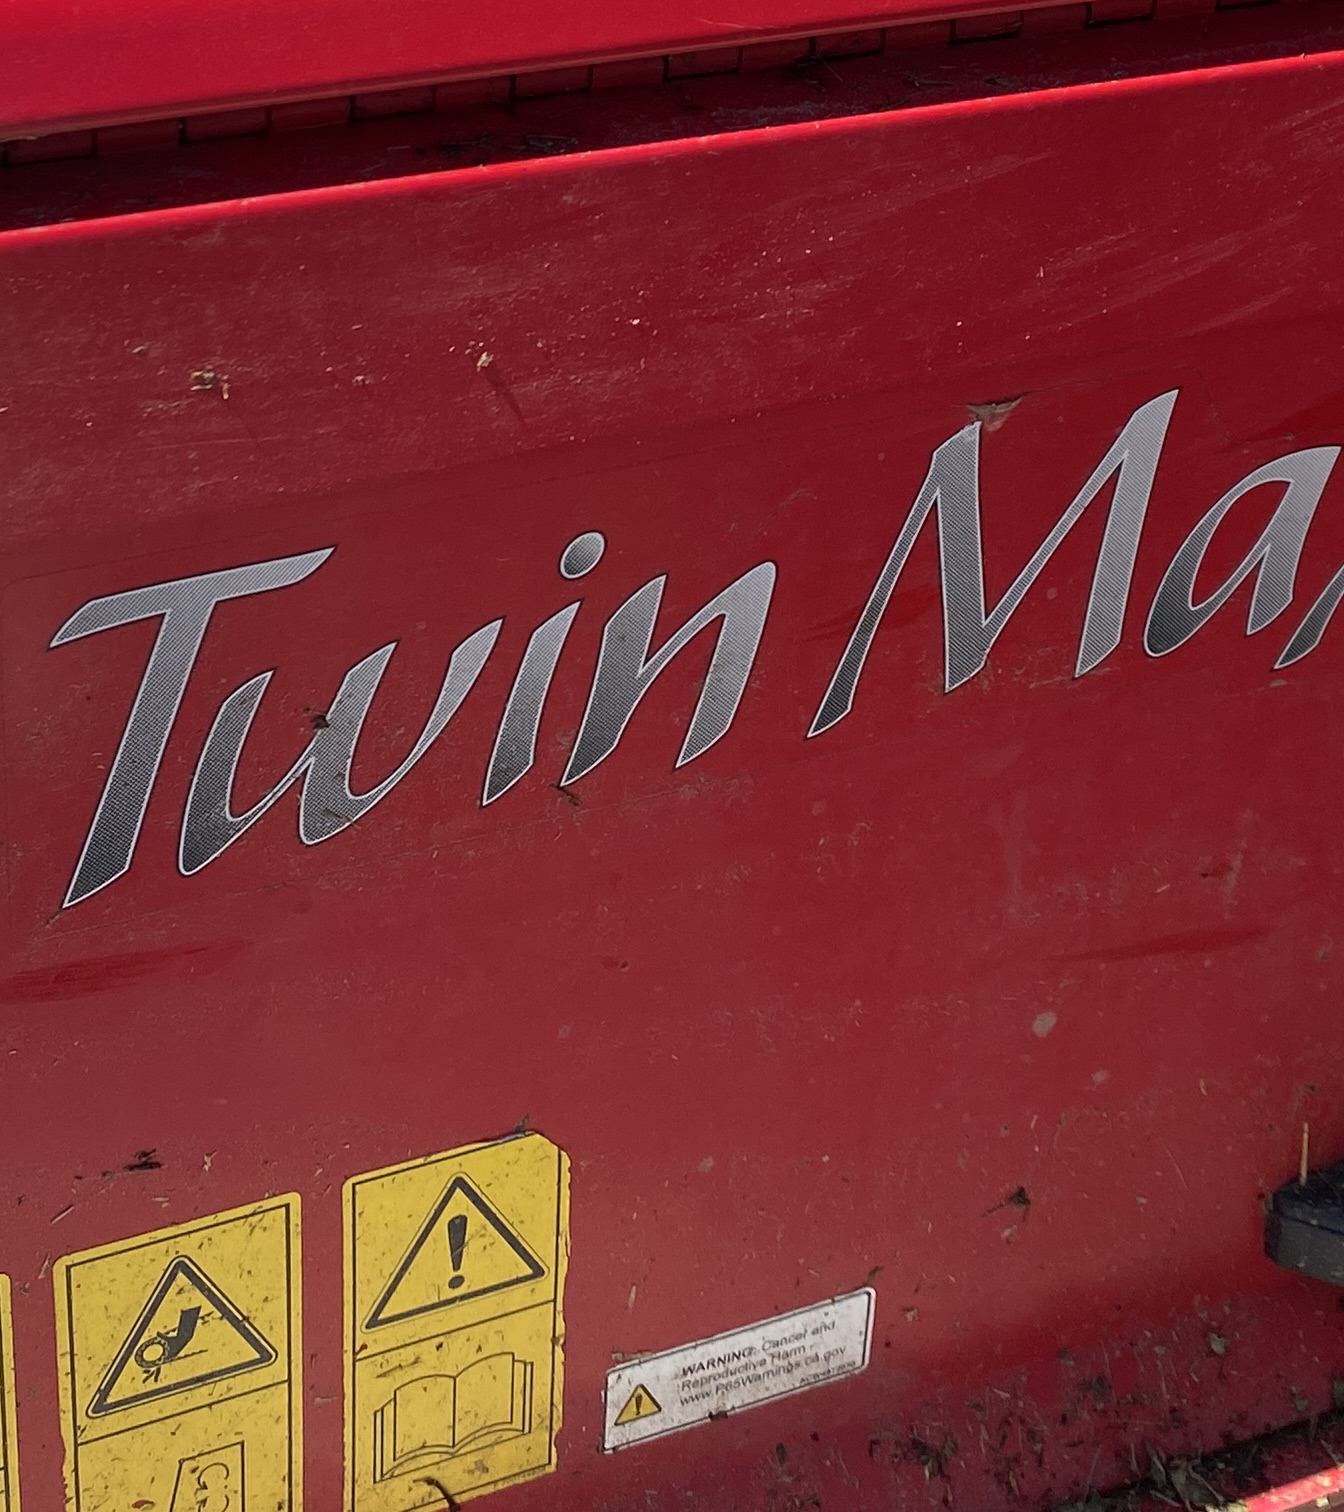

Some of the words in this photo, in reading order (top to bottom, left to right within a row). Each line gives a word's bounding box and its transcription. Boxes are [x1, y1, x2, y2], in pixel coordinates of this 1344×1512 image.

[48, 530, 778, 910] Twin
[680, 1346, 757, 1377] WARNING:
[761, 1328, 808, 1352] Cancer
[811, 1320, 836, 1336] and
[680, 1356, 767, 1392] Reproductive
[771, 1344, 806, 1364] Harm
